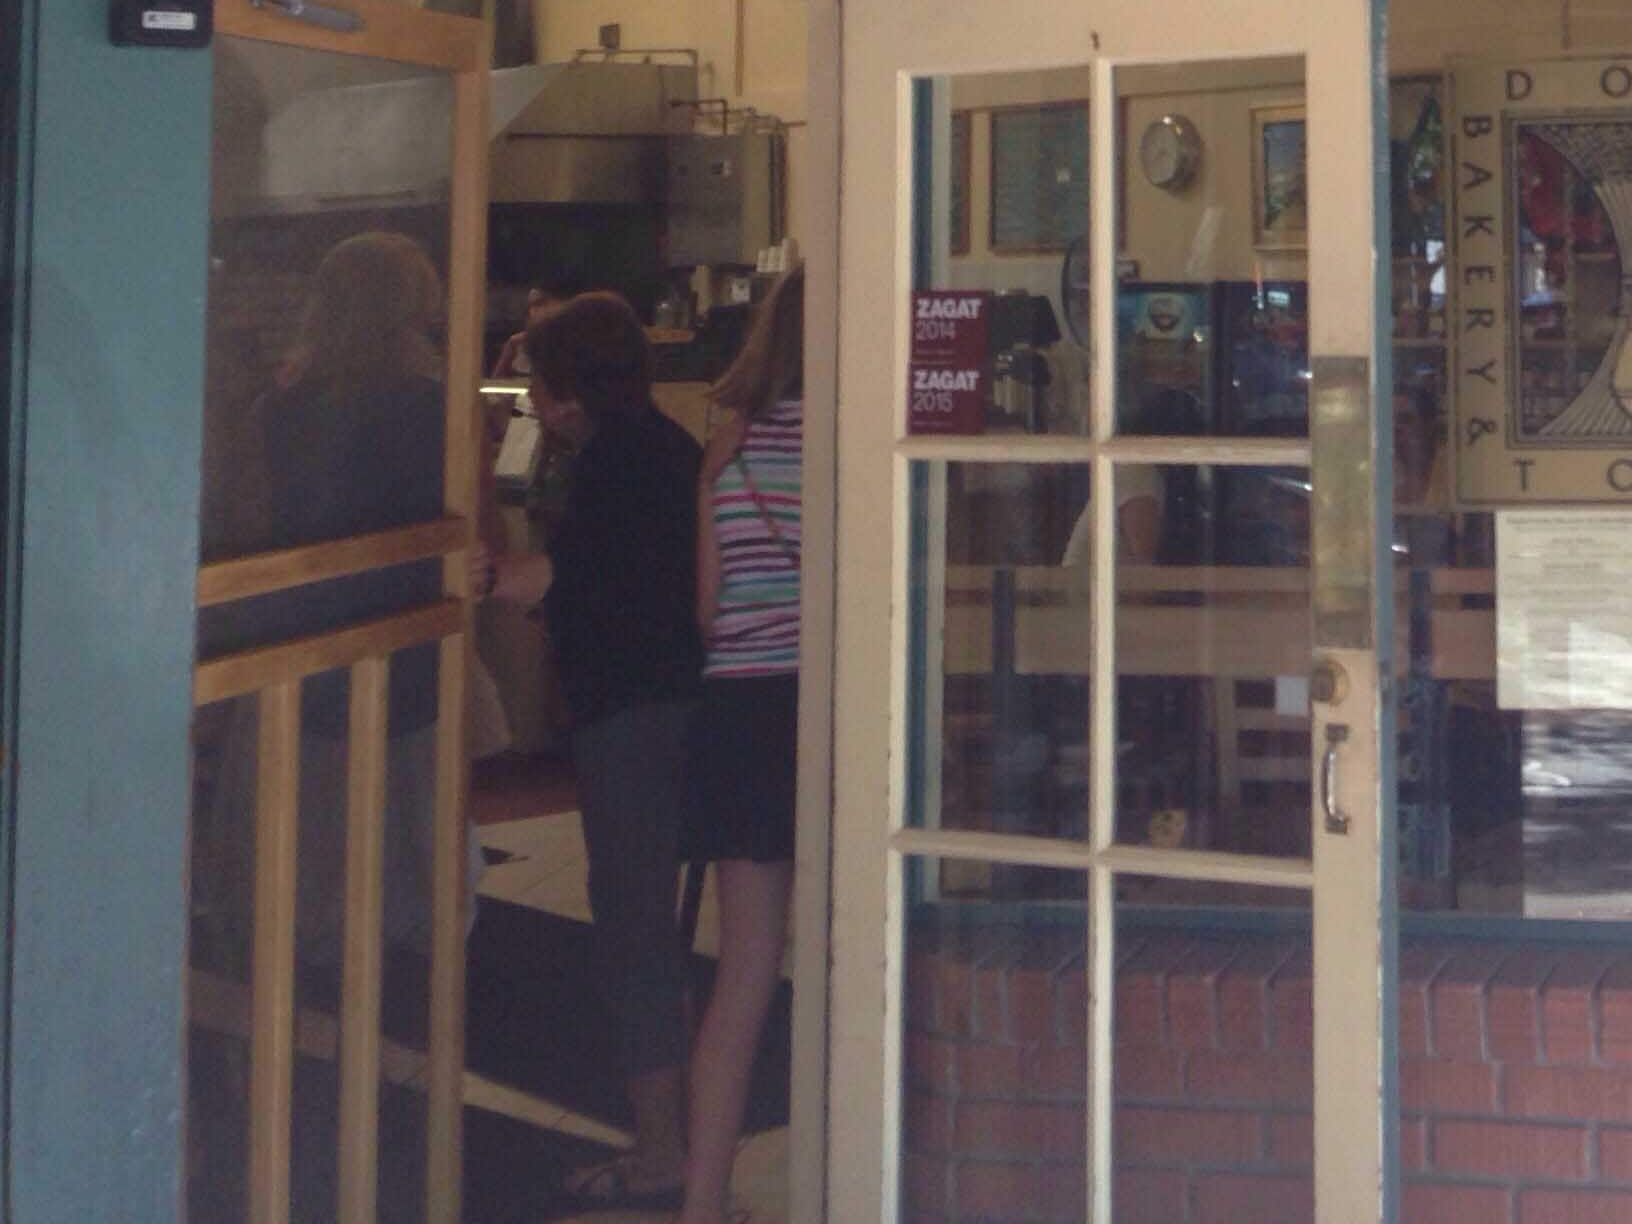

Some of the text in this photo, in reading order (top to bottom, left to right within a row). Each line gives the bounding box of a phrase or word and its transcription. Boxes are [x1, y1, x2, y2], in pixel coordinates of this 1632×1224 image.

[1462, 115, 1495, 384] BAKERY
[916, 297, 981, 319] ZAGAT
[914, 320, 956, 340] 2014
[914, 370, 980, 391] ZAGAT
